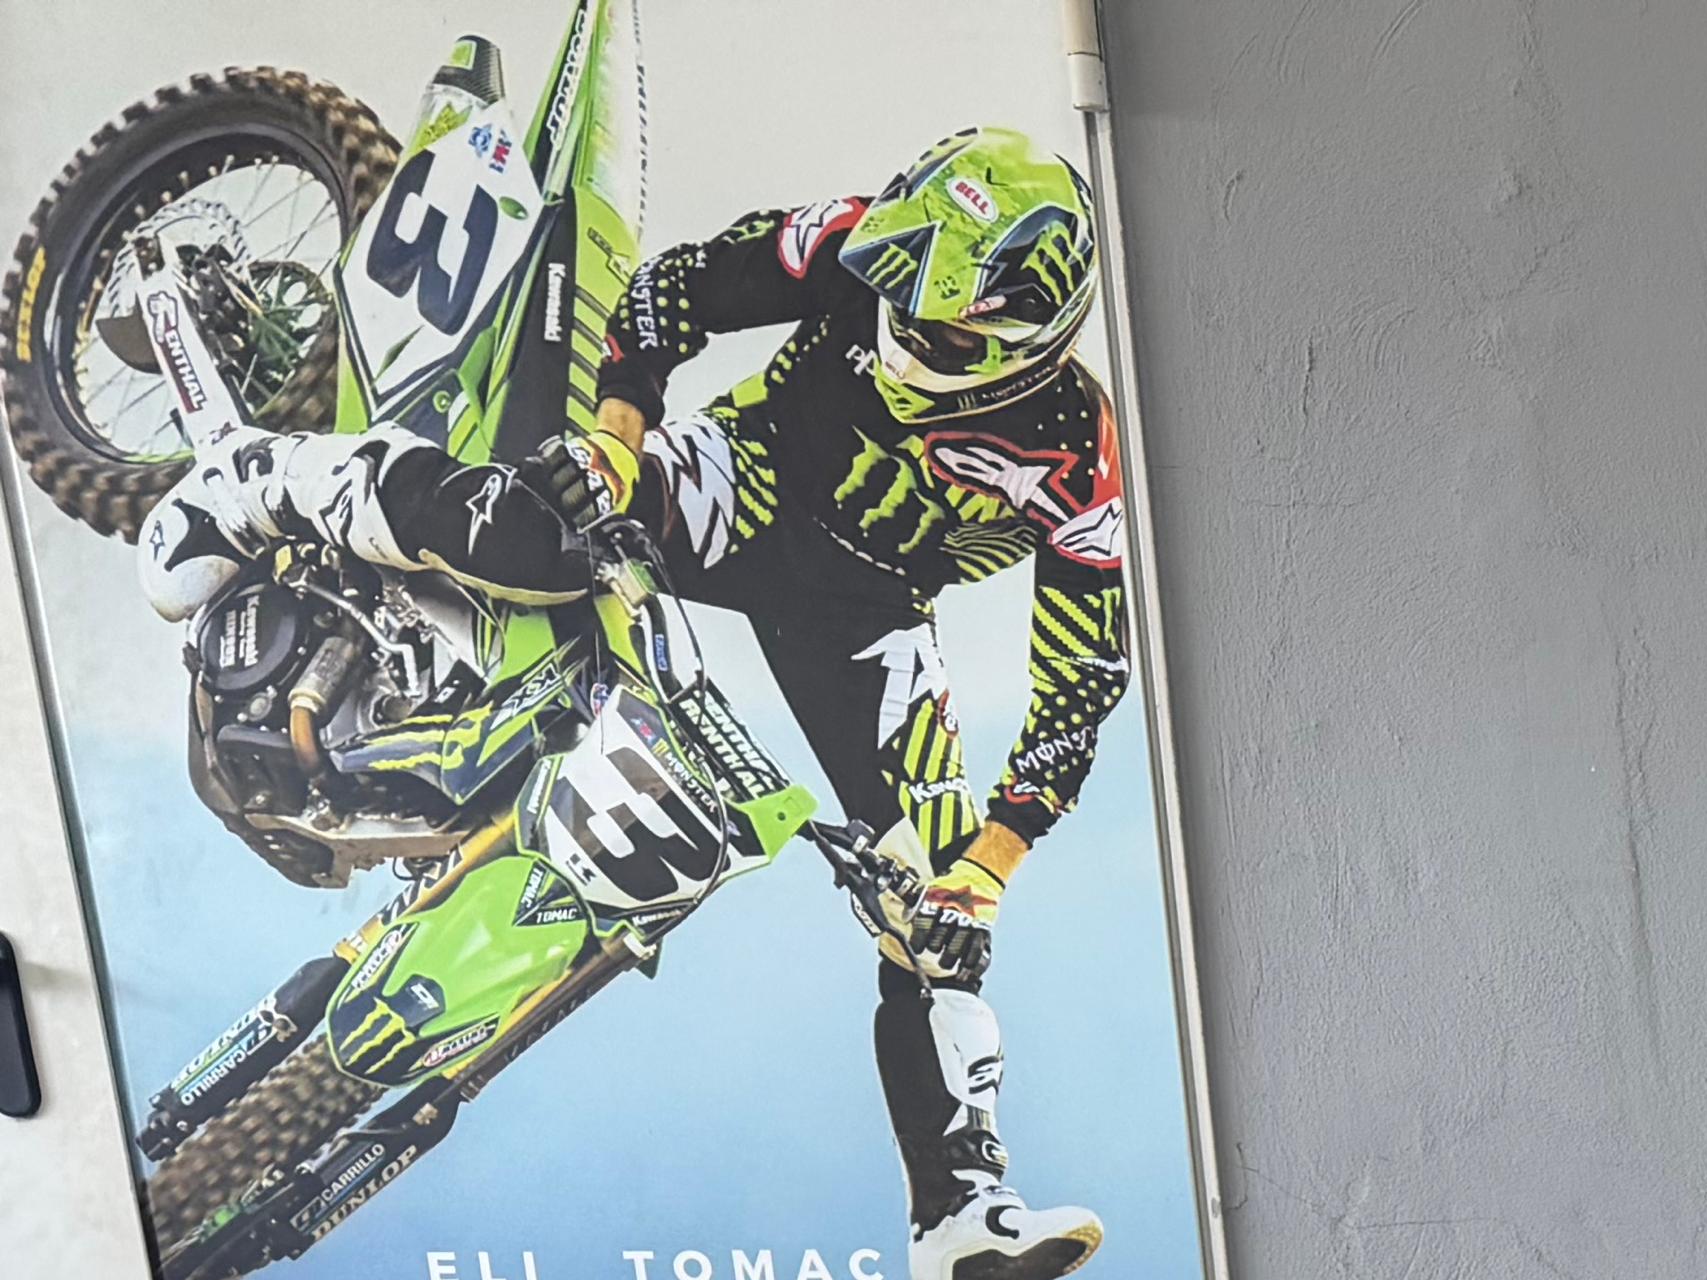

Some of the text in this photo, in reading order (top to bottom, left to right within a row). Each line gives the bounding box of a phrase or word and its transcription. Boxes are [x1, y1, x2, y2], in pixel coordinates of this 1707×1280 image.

[953, 181, 991, 216] BELL
[312, 1144, 417, 1241] DUNLOP
[320, 1143, 385, 1202] CARRILLO
